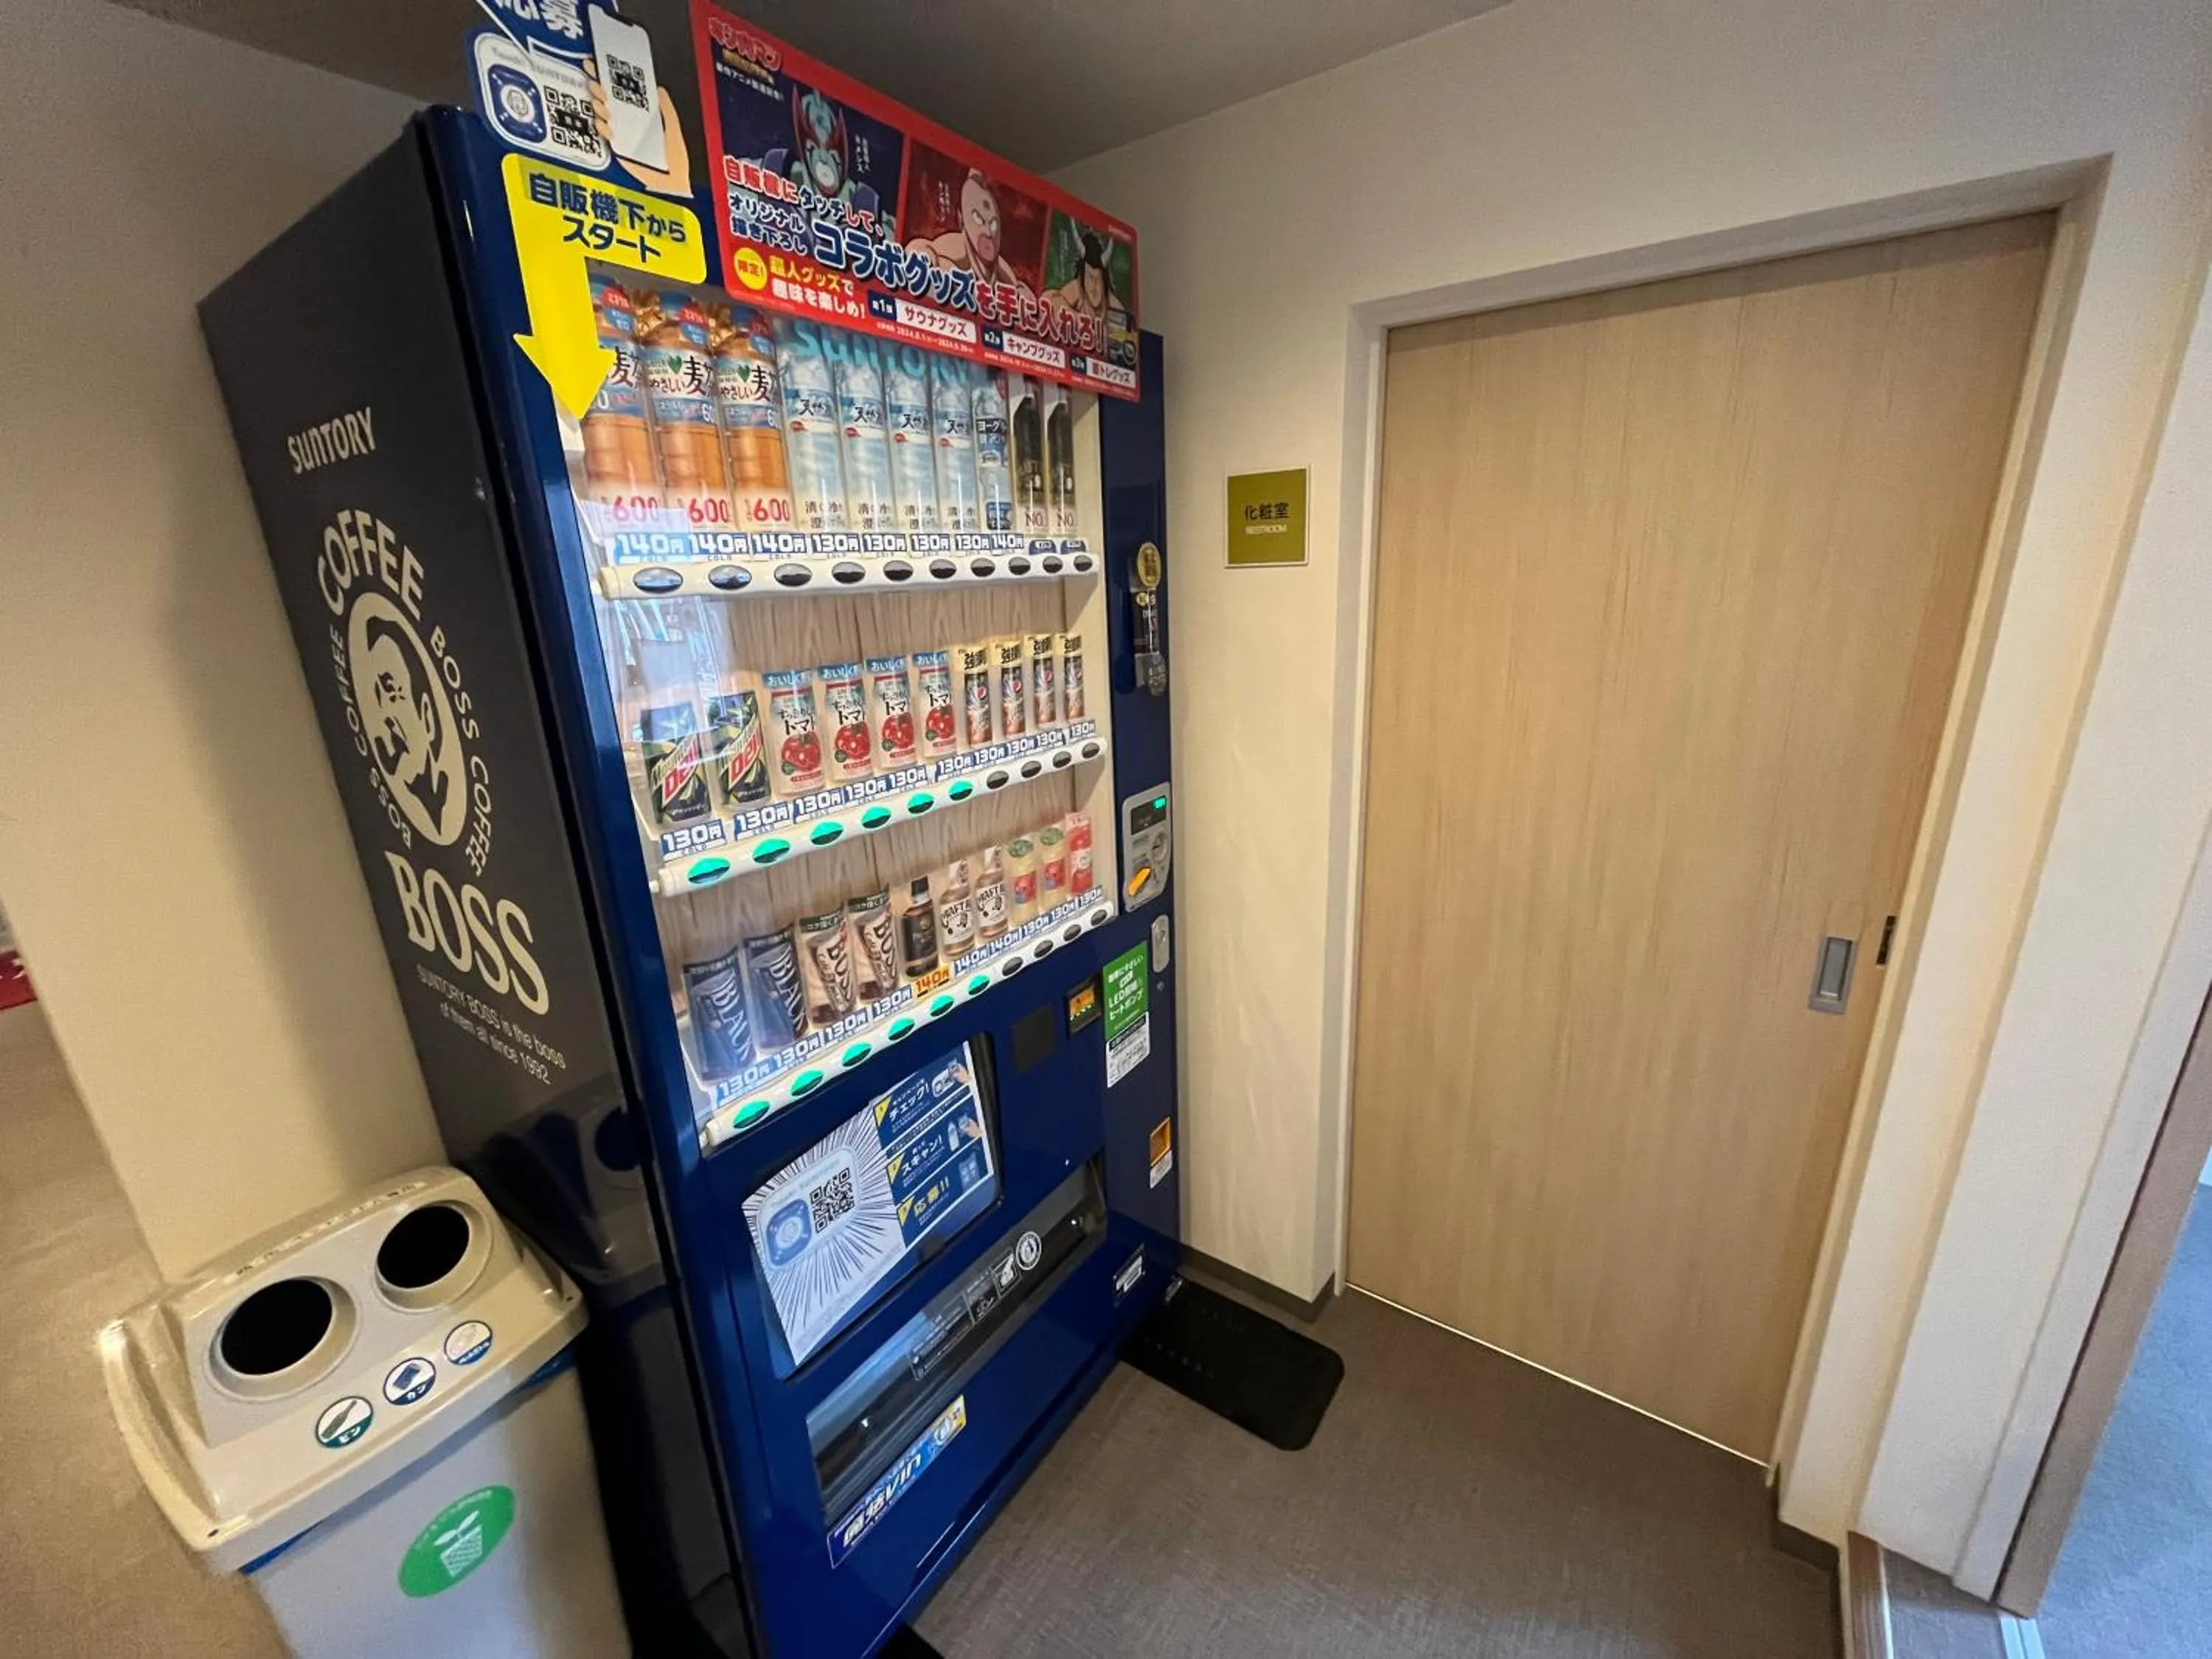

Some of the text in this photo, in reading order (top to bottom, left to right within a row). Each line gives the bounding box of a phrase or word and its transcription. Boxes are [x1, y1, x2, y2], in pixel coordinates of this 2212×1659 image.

[529, 173, 686, 243] 自販機下から
[729, 192, 805, 233] オリジナル
[563, 215, 661, 262] スタート
[905, 305, 967, 337] サウナグッズ
[1007, 338, 1060, 364] キャンプグッズ
[287, 406, 376, 474] SUNTORY
[613, 495, 660, 522] 600
[689, 497, 731, 523] 600
[754, 497, 790, 521] 600
[617, 534, 685, 554] 140円
[689, 534, 748, 553] 140円
[751, 534, 807, 552] 140円
[813, 534, 860, 552] 130円
[863, 534, 905, 552] 130円
[912, 534, 949, 552] 130円
[957, 534, 990, 551] 130円
[992, 534, 1023, 550] 140円
[317, 509, 425, 622] COFFEE
[431, 625, 492, 877] BOSS COFFEE
[975, 745, 1006, 764] 130円
[1008, 737, 1034, 756] 130円
[889, 767, 926, 788] 130円
[938, 756, 973, 775] 130円
[846, 777, 886, 799] 130円
[795, 790, 841, 815] 130円
[738, 804, 789, 832] 130円
[663, 824, 723, 852] 130円
[384, 850, 549, 1016] BOSS
[990, 931, 1020, 953] 140円
[954, 947, 988, 970] 140円
[915, 968, 950, 992] 140円
[873, 988, 912, 1017] 130円
[825, 1011, 868, 1040] 130円
[775, 1035, 821, 1069] 130円
[720, 1063, 771, 1097] 130円
